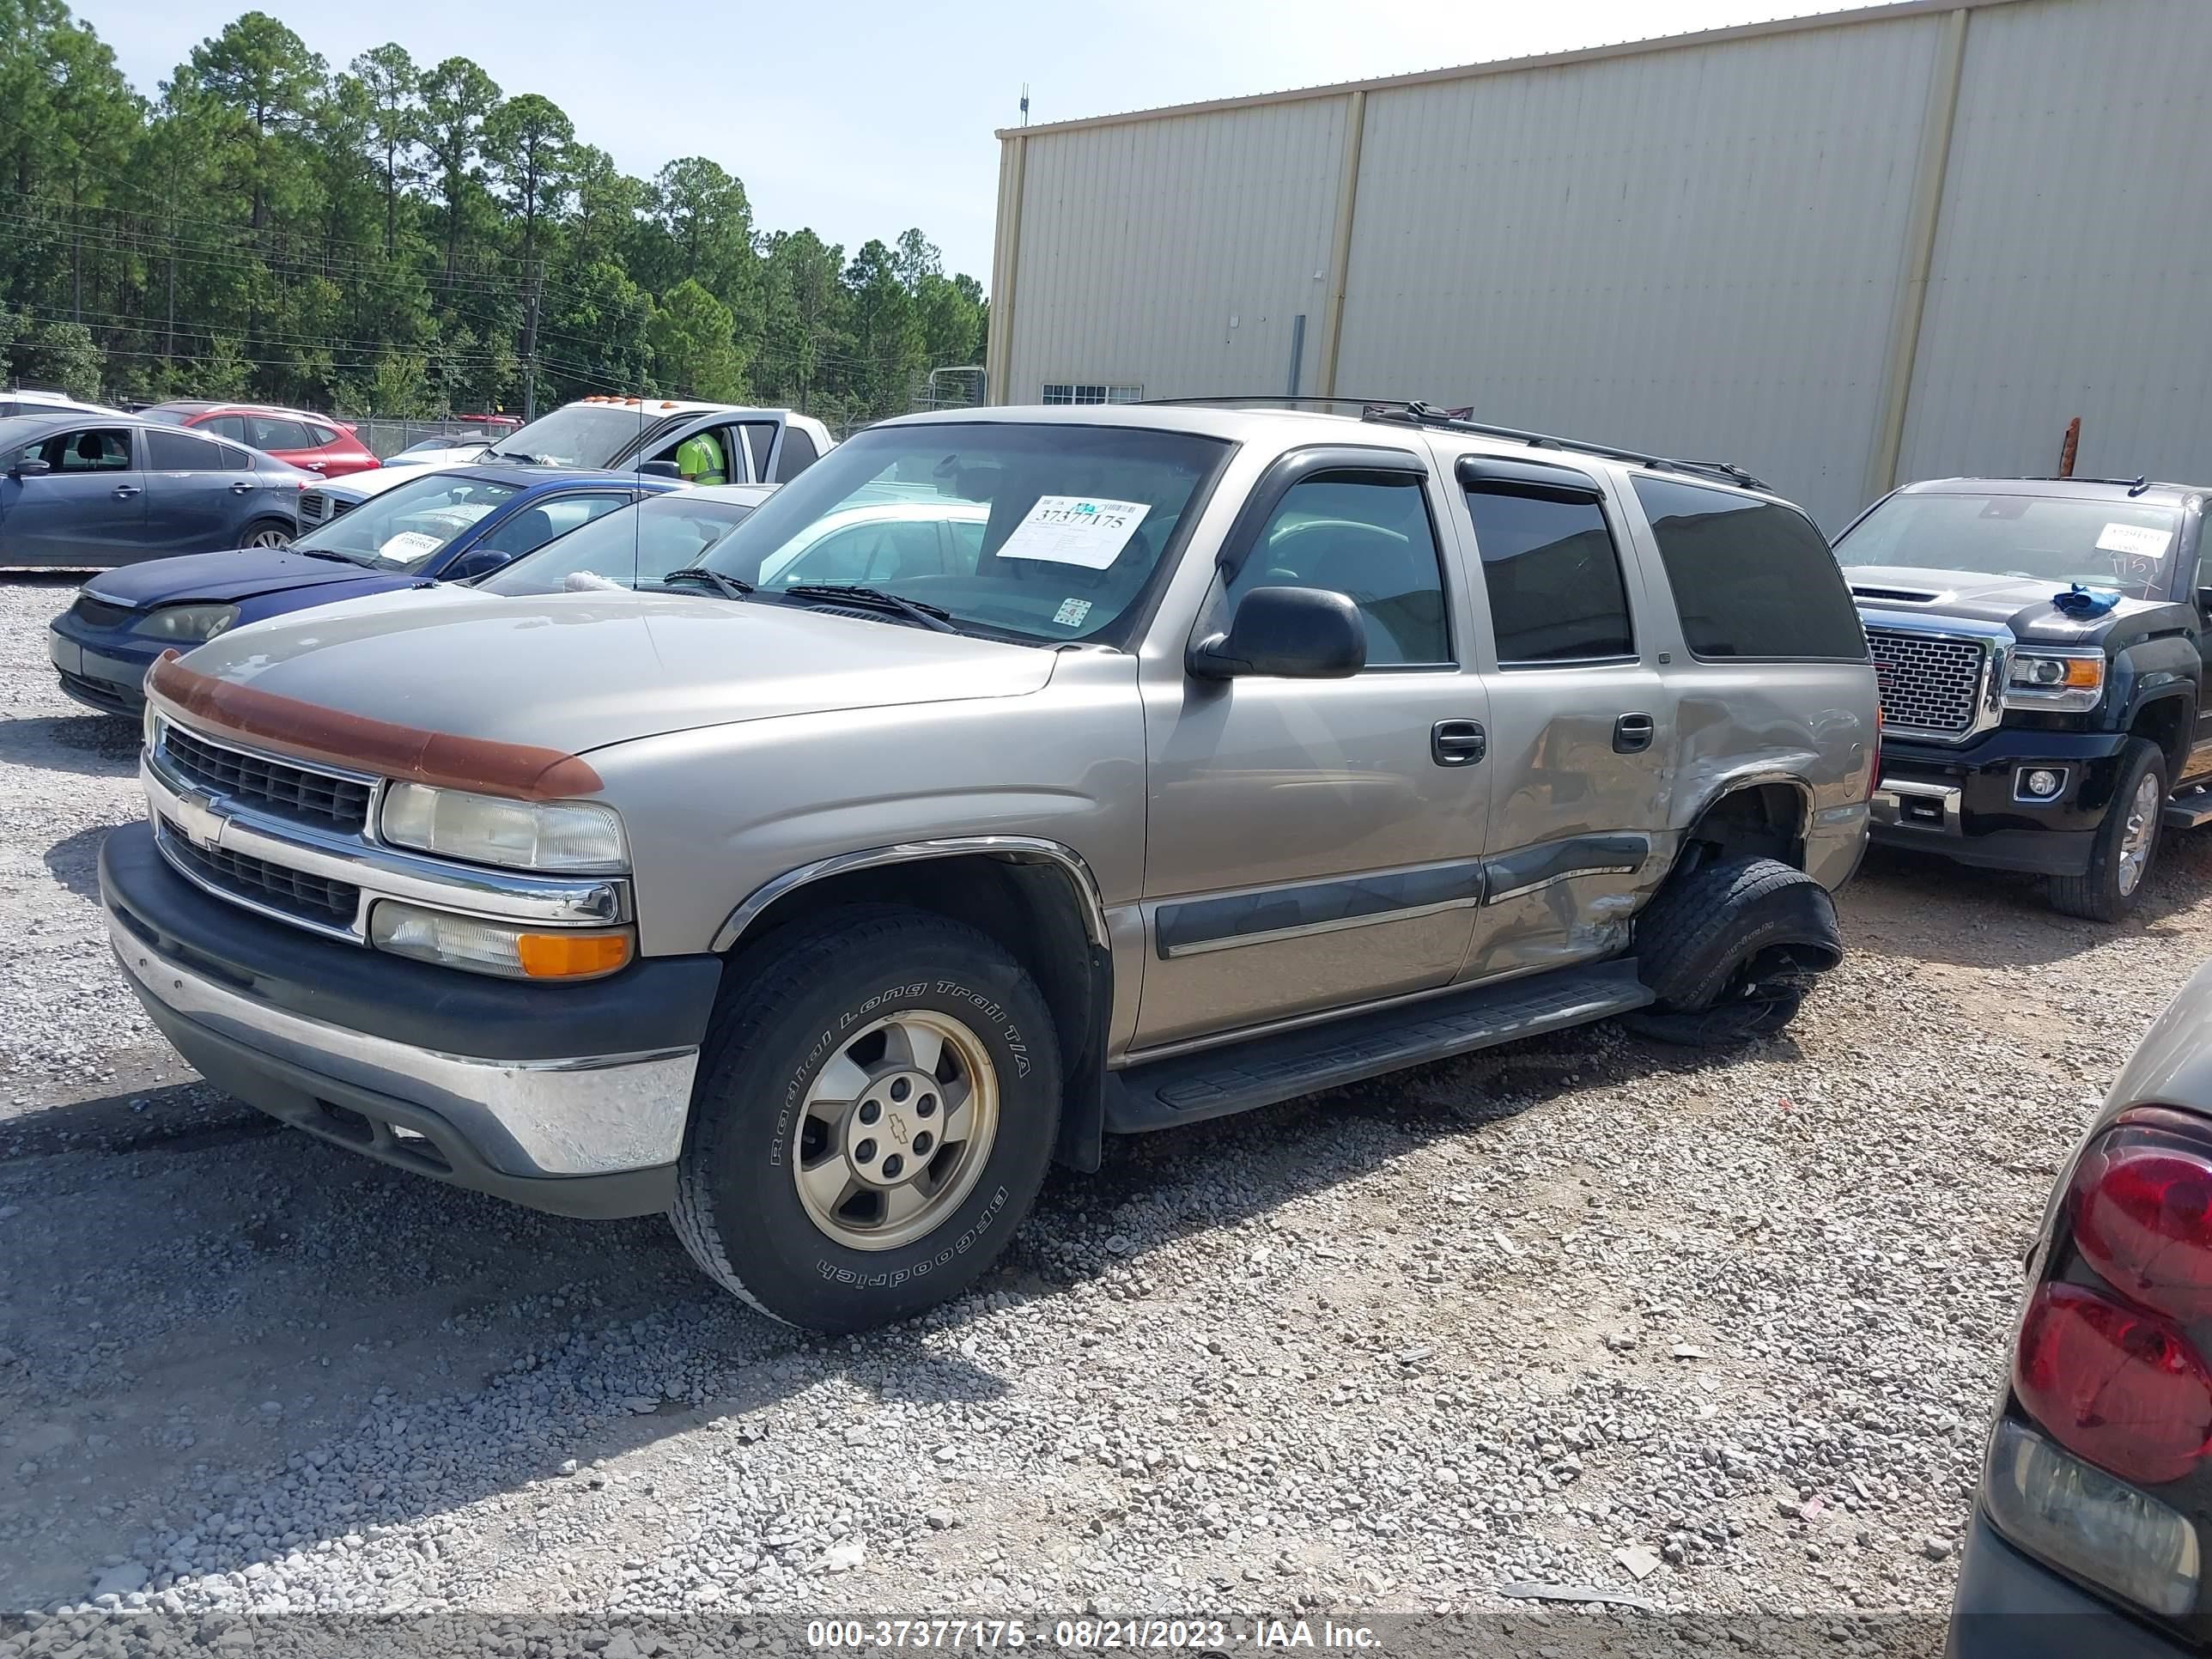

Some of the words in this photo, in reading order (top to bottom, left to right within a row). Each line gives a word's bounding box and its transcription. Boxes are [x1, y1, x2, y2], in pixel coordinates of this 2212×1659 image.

[1036, 509, 1127, 528] 37377175
[770, 1030, 832, 1166] Radial
[840, 982, 928, 1030] Long
[936, 980, 1007, 1024] Trail
[817, 1185, 1009, 1290] BFGoodrich
